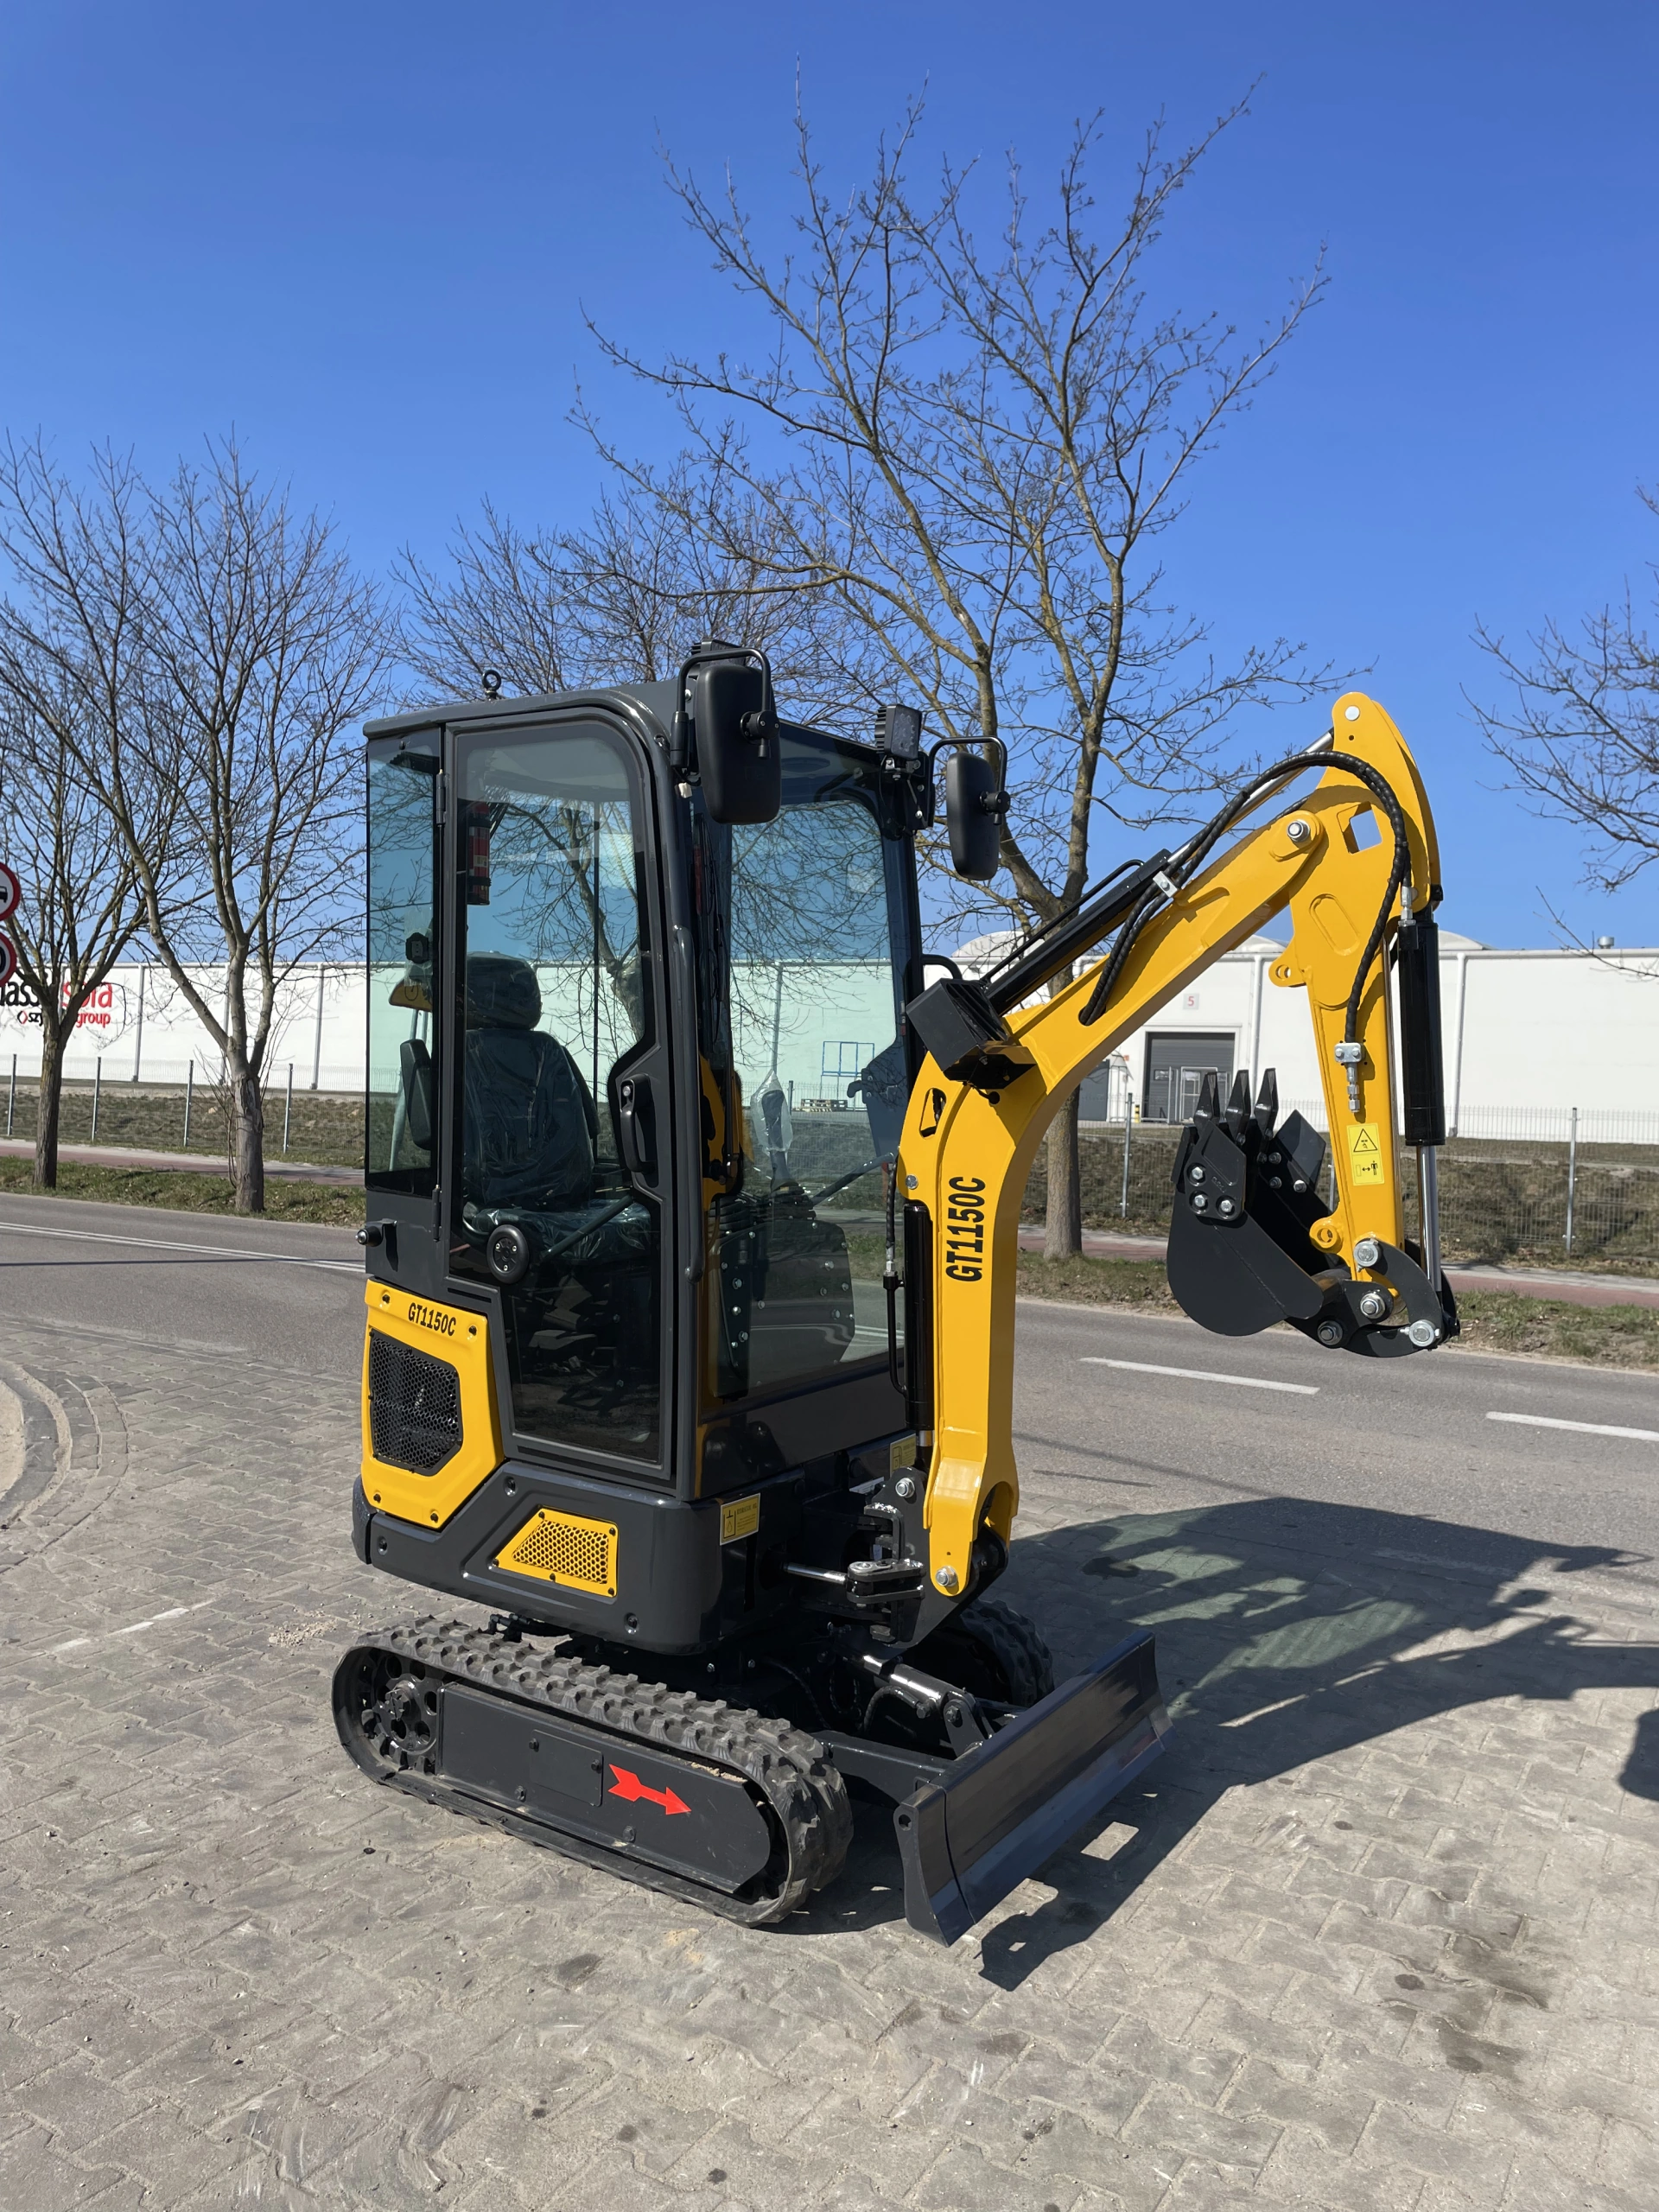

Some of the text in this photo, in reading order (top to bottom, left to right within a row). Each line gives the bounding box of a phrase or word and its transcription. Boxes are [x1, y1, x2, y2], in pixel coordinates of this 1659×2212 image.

[1187, 995, 1195, 1007] 5
[76, 1012, 111, 1028] group
[945, 1176, 986, 1282] GT1150C
[408, 1302, 456, 1337] GT1150C
